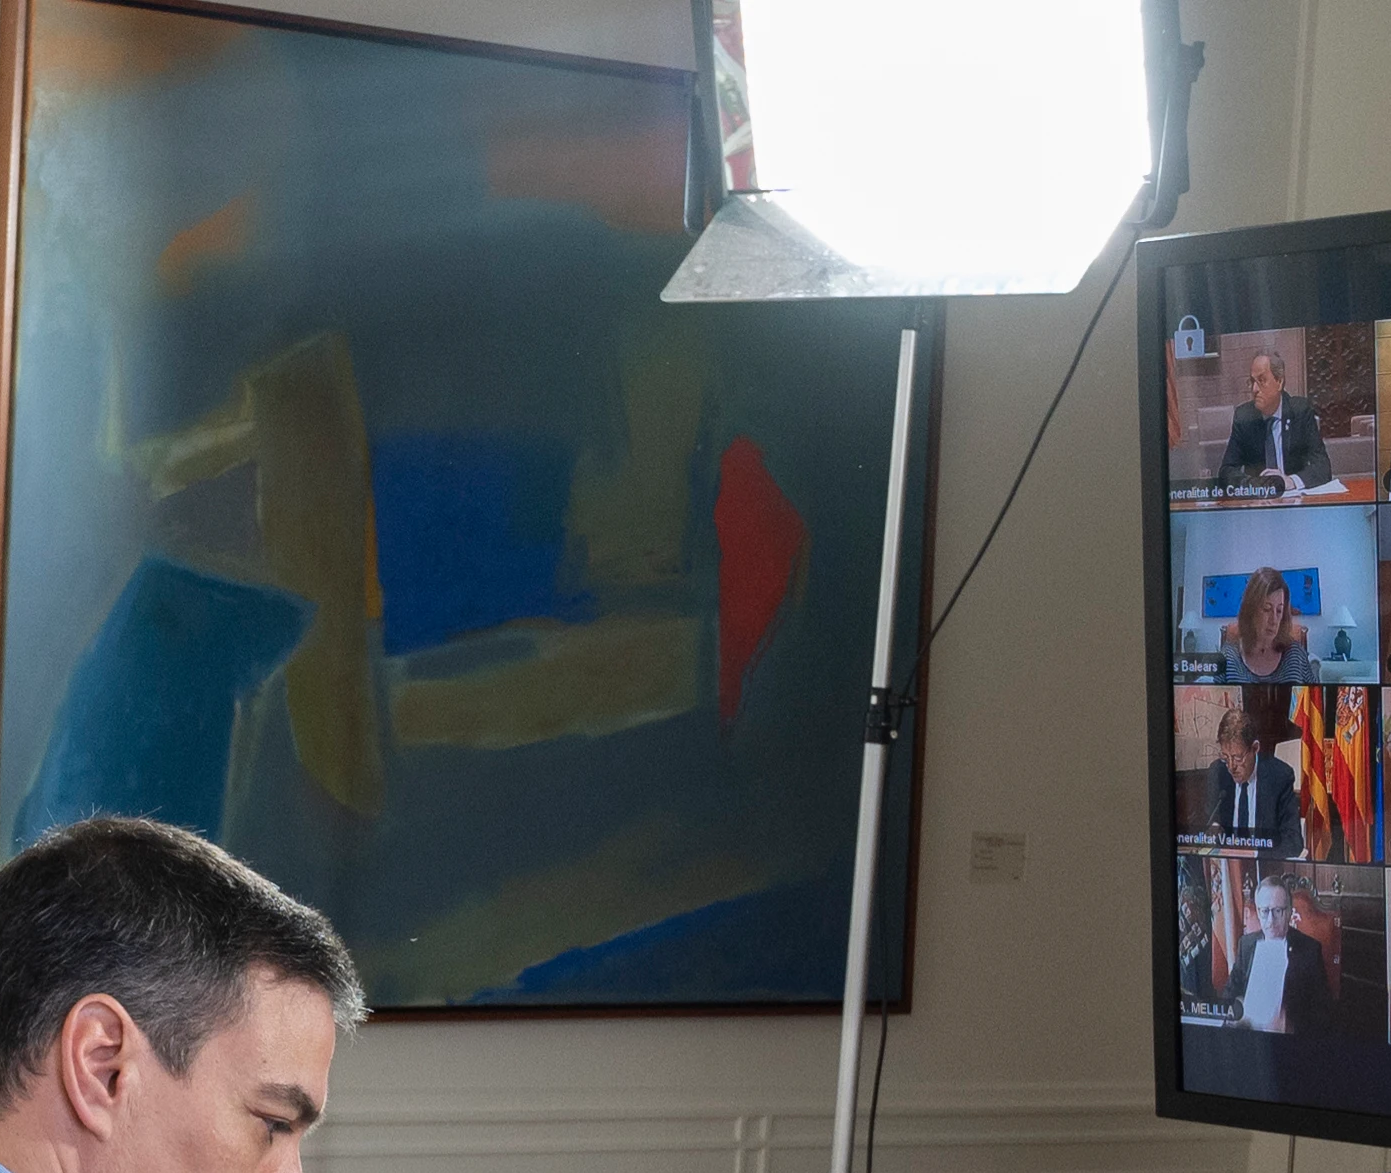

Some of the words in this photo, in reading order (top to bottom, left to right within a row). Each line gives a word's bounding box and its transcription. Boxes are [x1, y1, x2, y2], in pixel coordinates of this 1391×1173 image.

[1211, 485, 1224, 497] de
[1226, 483, 1276, 499] Catalunya
[1180, 659, 1218, 674] Balears
[1219, 833, 1273, 848] Valenciana
[1191, 1000, 1236, 1017] MELILLA
